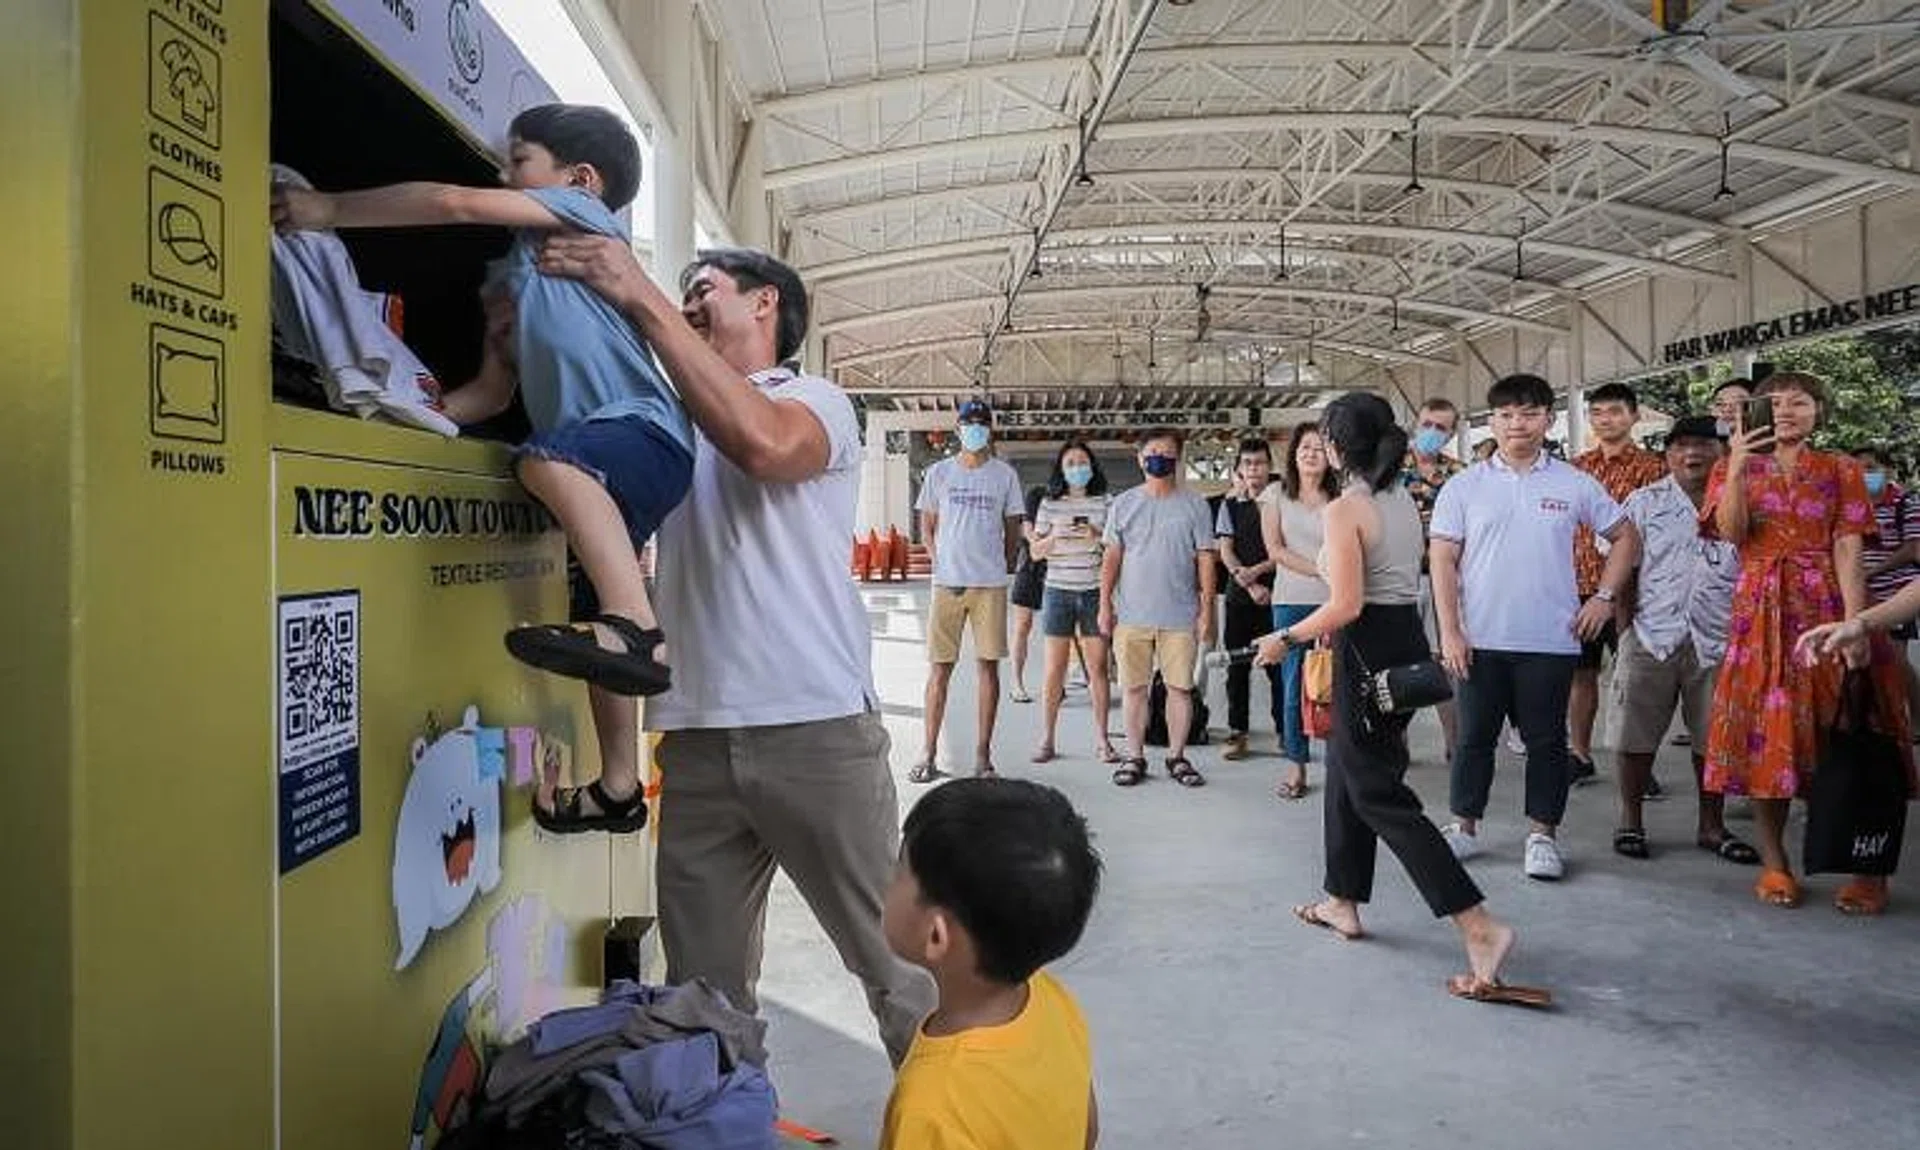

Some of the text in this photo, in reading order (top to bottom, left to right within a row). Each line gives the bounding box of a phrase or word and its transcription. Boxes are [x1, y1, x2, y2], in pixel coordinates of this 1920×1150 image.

[149, 133, 222, 182] CLOTHES
[131, 282, 238, 330] HATS & CAPS
[1702, 318, 1785, 354] WARGA
[1789, 301, 1860, 337] EMAS
[996, 411, 1025, 426] NEE
[1030, 411, 1075, 426] SOON
[1079, 410, 1116, 426] EAST
[151, 450, 225, 475] PILLOWS
[294, 486, 375, 536] NEE
[381, 492, 461, 536] SOON
[1852, 830, 1888, 857] HAY
